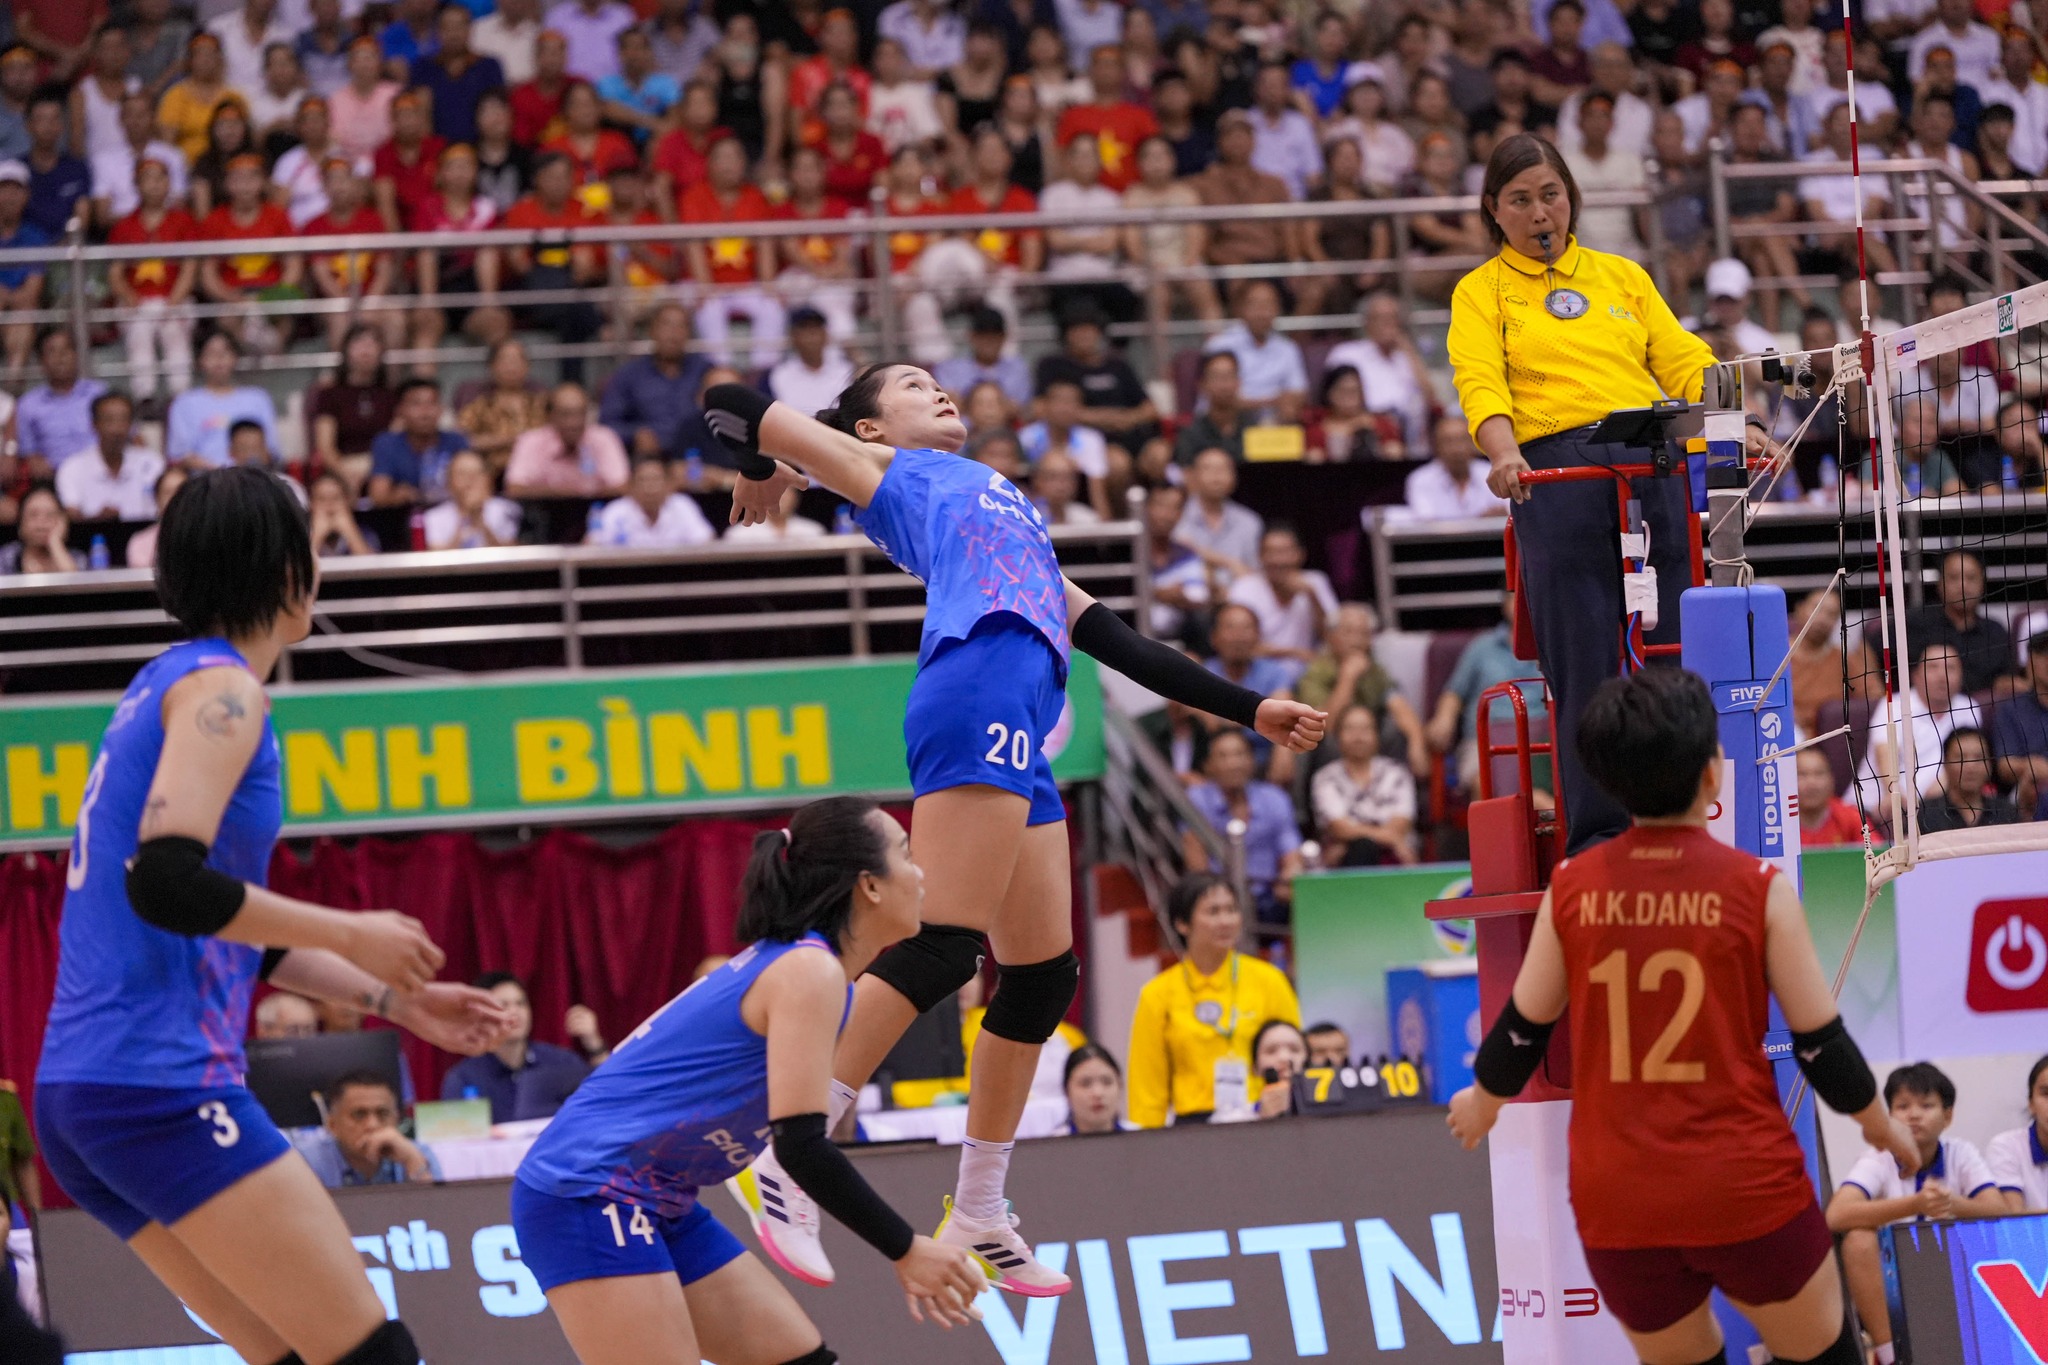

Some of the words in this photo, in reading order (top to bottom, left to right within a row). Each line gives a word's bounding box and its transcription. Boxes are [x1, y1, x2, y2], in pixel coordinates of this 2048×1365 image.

[0, 743, 89, 830] H
[285, 723, 471, 814] NH
[515, 697, 832, 803] BÌNH
[985, 722, 1029, 770] 20
[1762, 742, 1782, 845] Senoh
[1579, 890, 1722, 927] N.K.DANG
[1588, 949, 1706, 1083] 12
[1304, 1067, 1335, 1103] 7
[1380, 1062, 1420, 1097] 10
[198, 1101, 240, 1148] 3
[601, 1202, 654, 1247] 14
[976, 1212, 1502, 1365] VIETN
[1501, 1288, 1546, 1318] BYD
